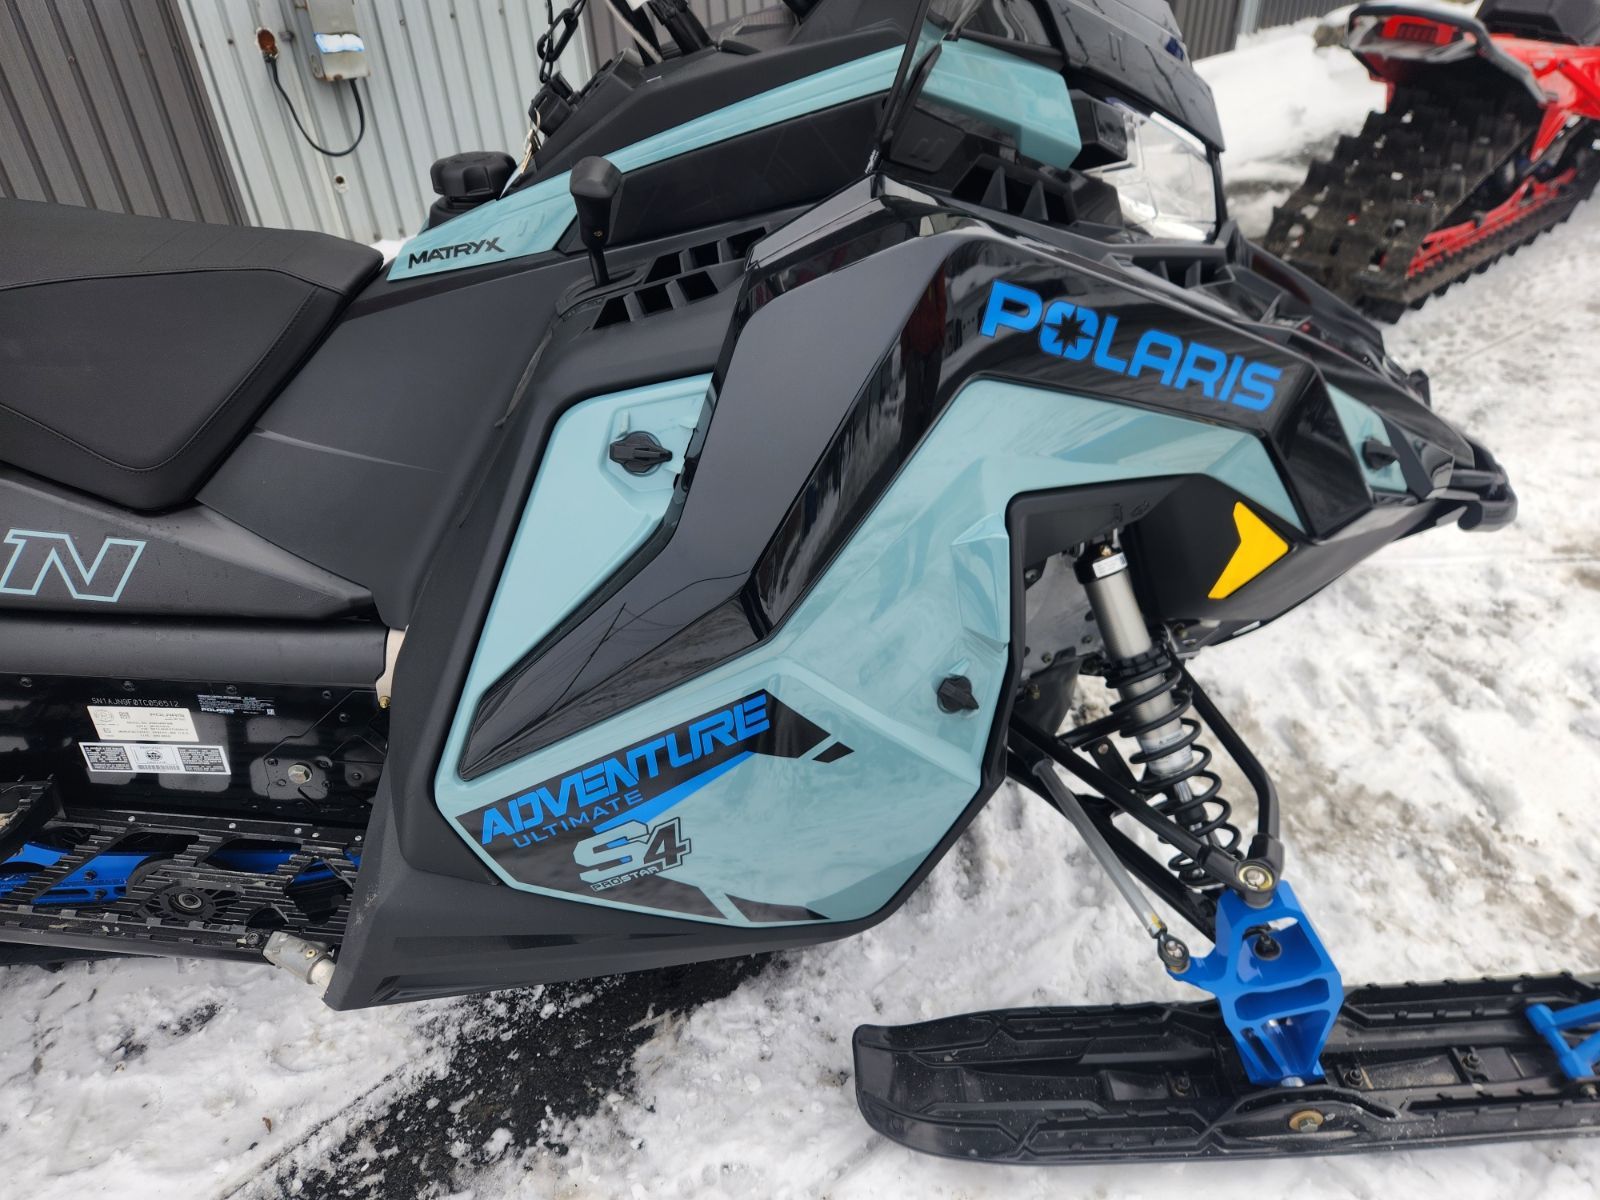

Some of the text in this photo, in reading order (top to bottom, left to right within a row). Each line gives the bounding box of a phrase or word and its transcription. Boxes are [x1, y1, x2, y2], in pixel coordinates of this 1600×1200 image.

[408, 237, 506, 269] MATRYX
[980, 279, 1283, 411] POLARIS
[482, 694, 770, 845] ADVENTURE
[513, 789, 643, 848] ULTIMATE
